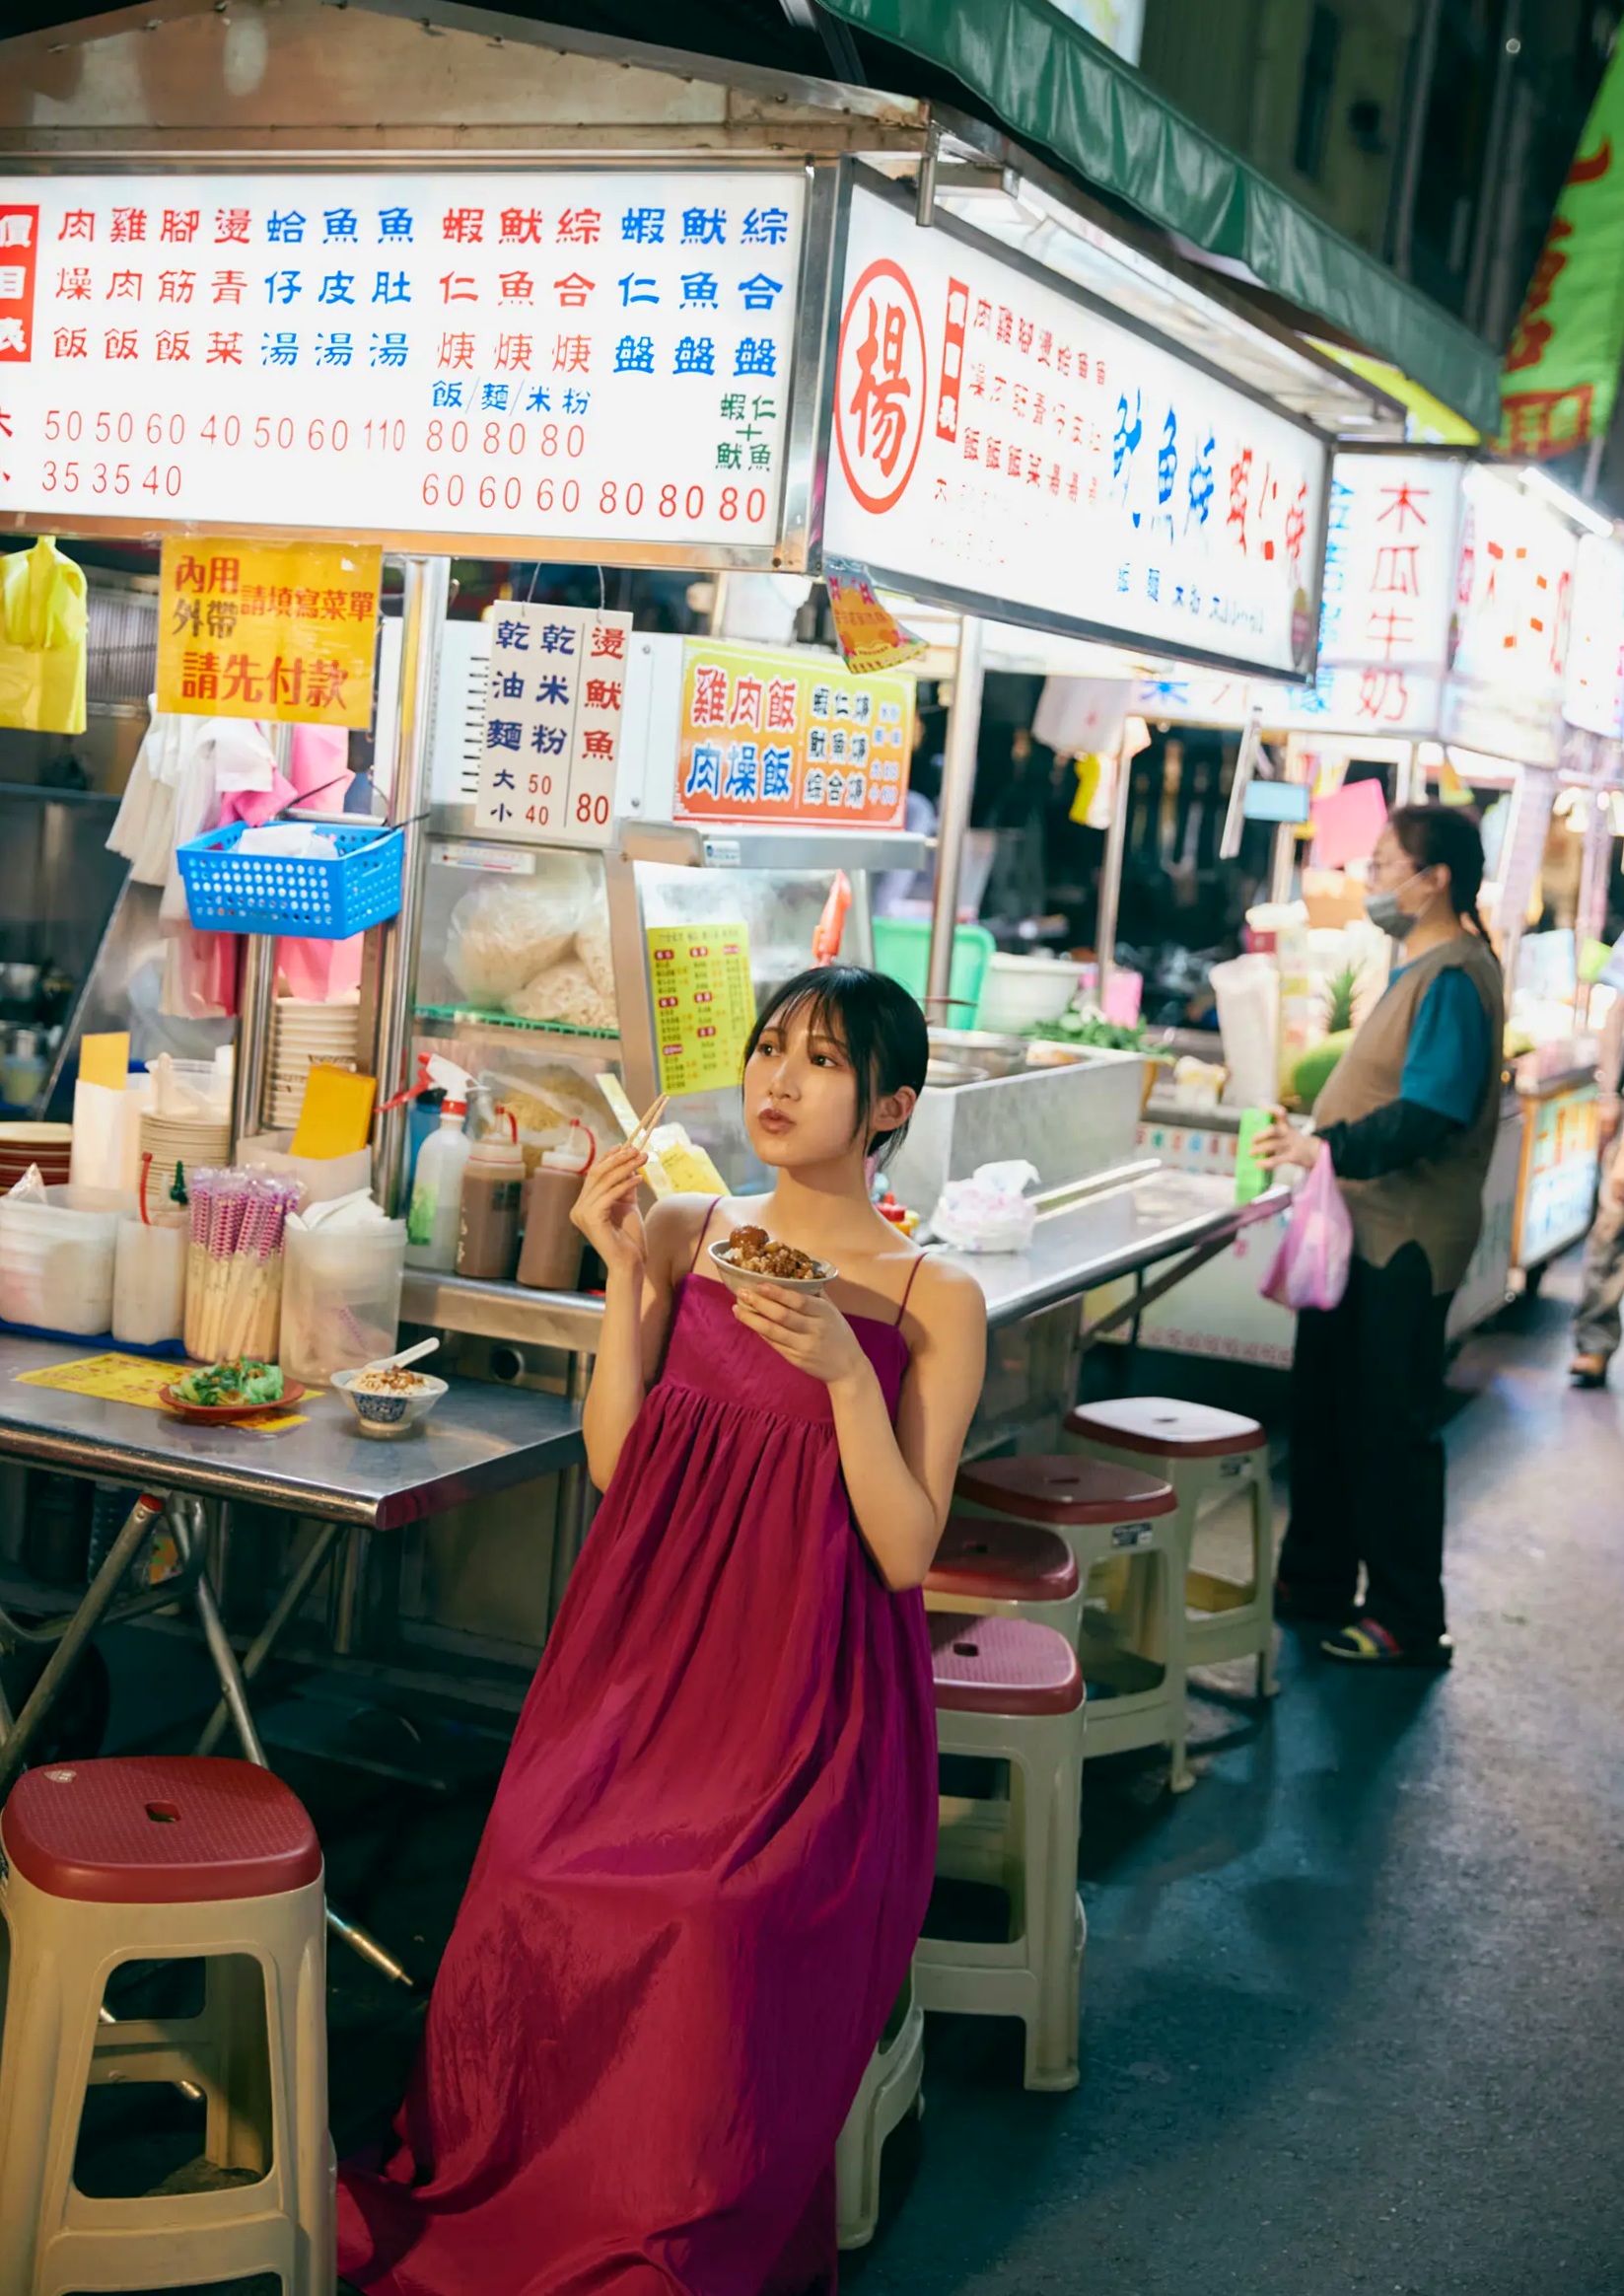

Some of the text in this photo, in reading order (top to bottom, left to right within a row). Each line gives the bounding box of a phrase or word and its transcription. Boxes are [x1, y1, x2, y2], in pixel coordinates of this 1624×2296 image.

[52, 207, 97, 359] 肉燥飯
[104, 207, 148, 361] 雞肉飯
[155, 208, 201, 362] 腳筋飯
[205, 208, 252, 366] 燙青菜
[259, 209, 308, 367] 蛤仔湯
[314, 206, 360, 368] 魚皮湯
[368, 205, 415, 368] 魚肚湯
[611, 206, 667, 375] 蝦仁盤
[671, 206, 728, 377] 魷魚盤
[732, 206, 789, 379] 綜合盤
[44, 408, 83, 443] 50
[96, 410, 134, 443] 50
[145, 412, 186, 446] 60
[199, 413, 242, 448] 40
[254, 415, 295, 451] 50
[307, 417, 349, 453] 60
[364, 418, 405, 453] 110
[425, 418, 469, 454] 80
[482, 420, 527, 456] 80
[539, 423, 586, 459] 80
[720, 394, 777, 420] 蝦仁
[849, 296, 911, 478] 楊
[41, 460, 767, 525] 35 35 40 60 60 60 80 80 80
[715, 442, 772, 472] 魷魚
[173, 598, 239, 638] 外帶
[241, 585, 375, 621] 請填寫菜單
[1354, 483, 1430, 722] 木瓜牛奶
[181, 652, 348, 709] 請先付款
[486, 618, 530, 752] 乾油麵
[531, 622, 576, 754] 乾米粉
[582, 626, 625, 761] 燙魷魚
[693, 667, 796, 728] 雞肉飯
[490, 803, 549, 825] 小 40
[493, 769, 552, 795] 大 50
[577, 793, 608, 825] 80
[687, 744, 791, 797] 肉燥飯
